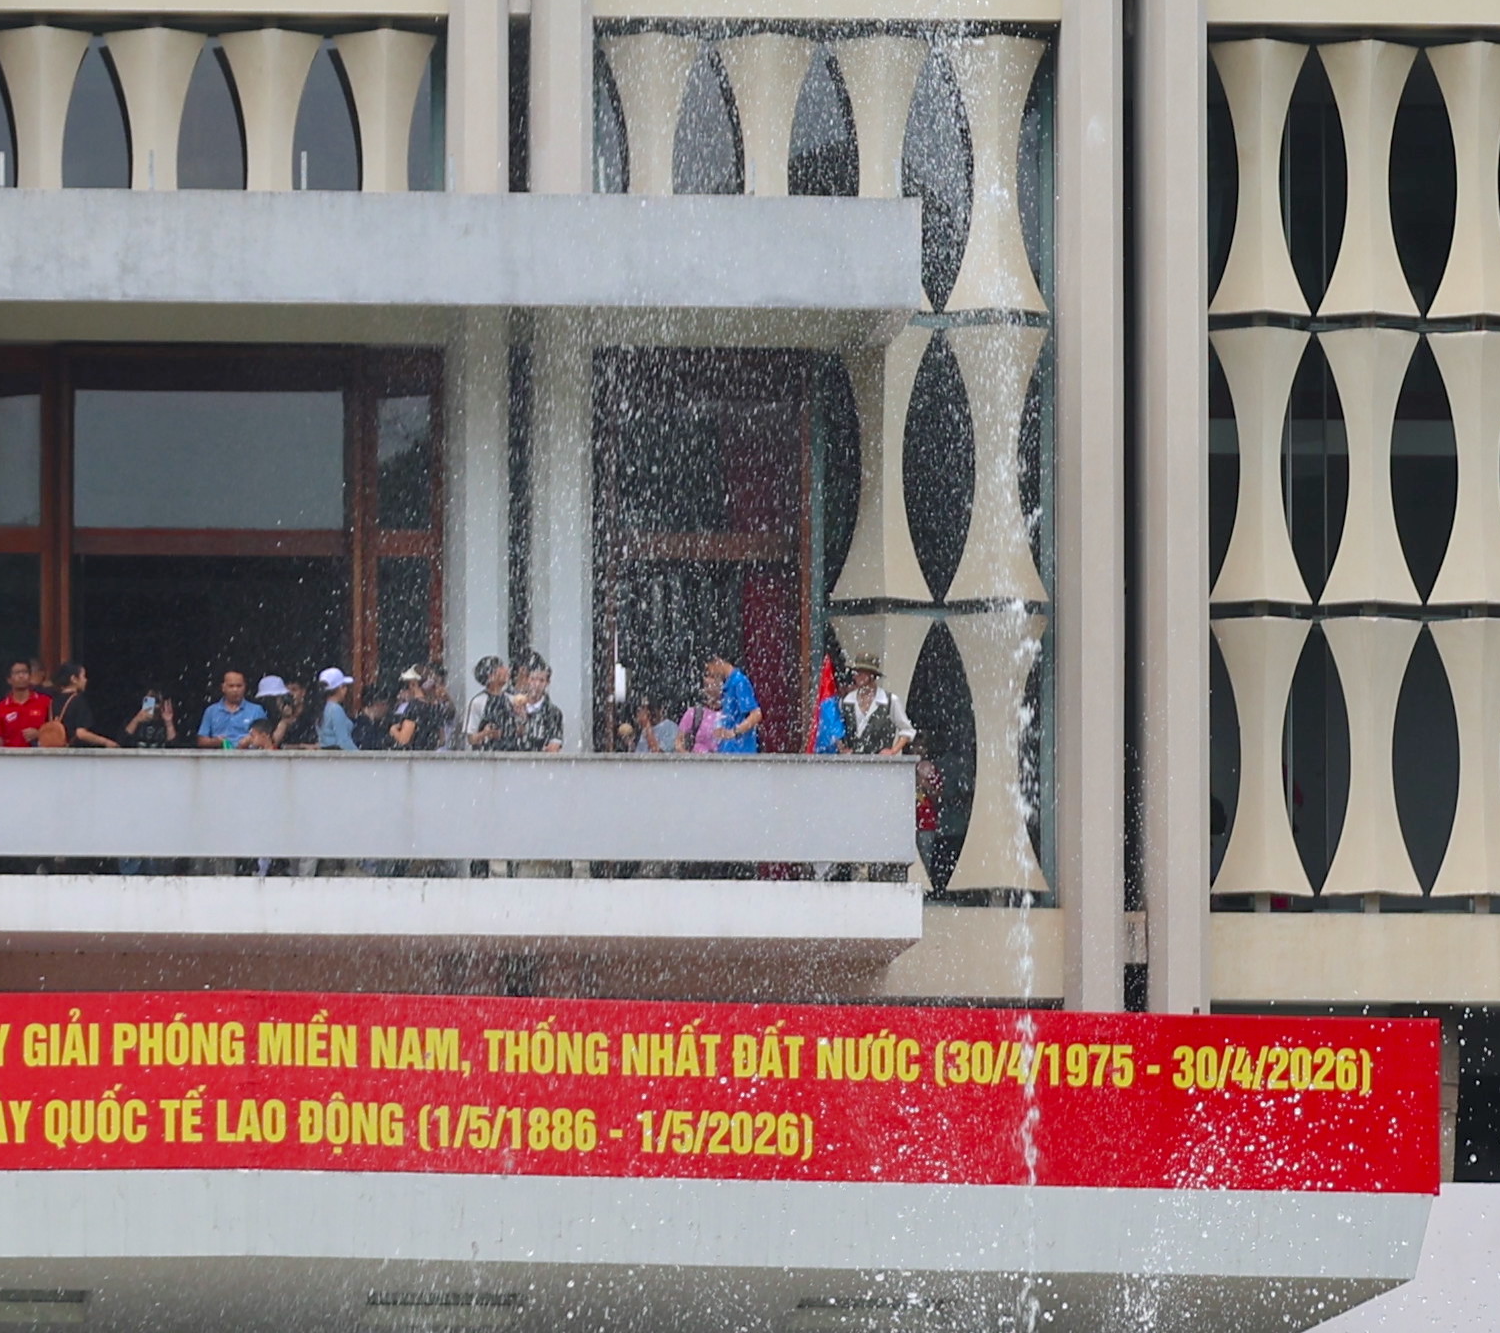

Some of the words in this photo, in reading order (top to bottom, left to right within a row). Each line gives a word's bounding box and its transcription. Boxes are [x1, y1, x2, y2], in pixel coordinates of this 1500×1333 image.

[22, 1008, 100, 1068] GIẢI
[112, 1013, 245, 1067] PHÓNG
[257, 1010, 358, 1068] MIỀN
[370, 1026, 472, 1075] NAM,
[483, 1013, 609, 1076] THỐNG
[621, 1019, 722, 1078] NHẤT
[731, 1020, 805, 1079] ĐẤT
[816, 1030, 921, 1083] NƯỚC
[934, 1040, 1134, 1088] (30/4/1975
[1146, 1064, 1161, 1075] -
[1172, 1045, 1372, 1095] 30/4/2026)
[44, 1084, 148, 1148] QUỐC
[159, 1084, 206, 1143] TẾ
[216, 1098, 288, 1144] LAO
[297, 1092, 405, 1155] ĐỘNG
[418, 1105, 597, 1152] (1/5/1886
[609, 1129, 624, 1139] -
[639, 1110, 813, 1161] 1/5/2026)
